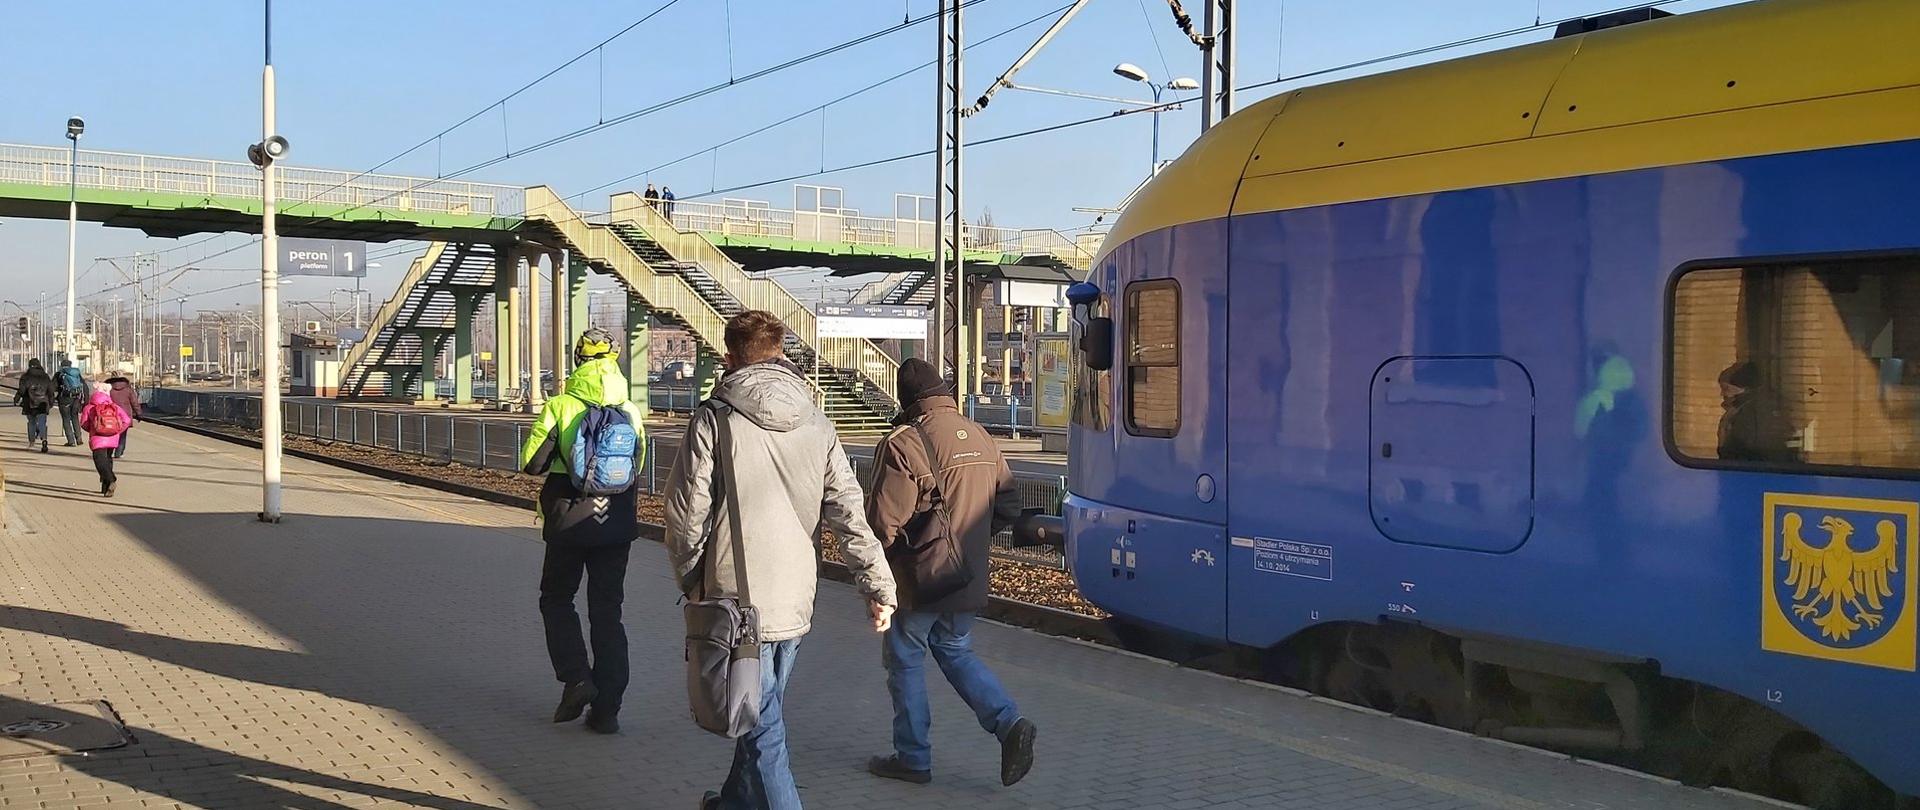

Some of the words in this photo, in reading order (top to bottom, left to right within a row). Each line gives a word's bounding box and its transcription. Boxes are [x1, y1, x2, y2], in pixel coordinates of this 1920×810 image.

[289, 250, 328, 262] peron
[343, 251, 353, 272] 1
[1256, 540, 1277, 549] Stadler
[1278, 542, 1299, 552] Polska
[1256, 549, 1278, 559] Poziom
[1285, 554, 1319, 566] utrzymania
[1311, 610, 1319, 620] L1
[1767, 689, 1782, 703] L2
